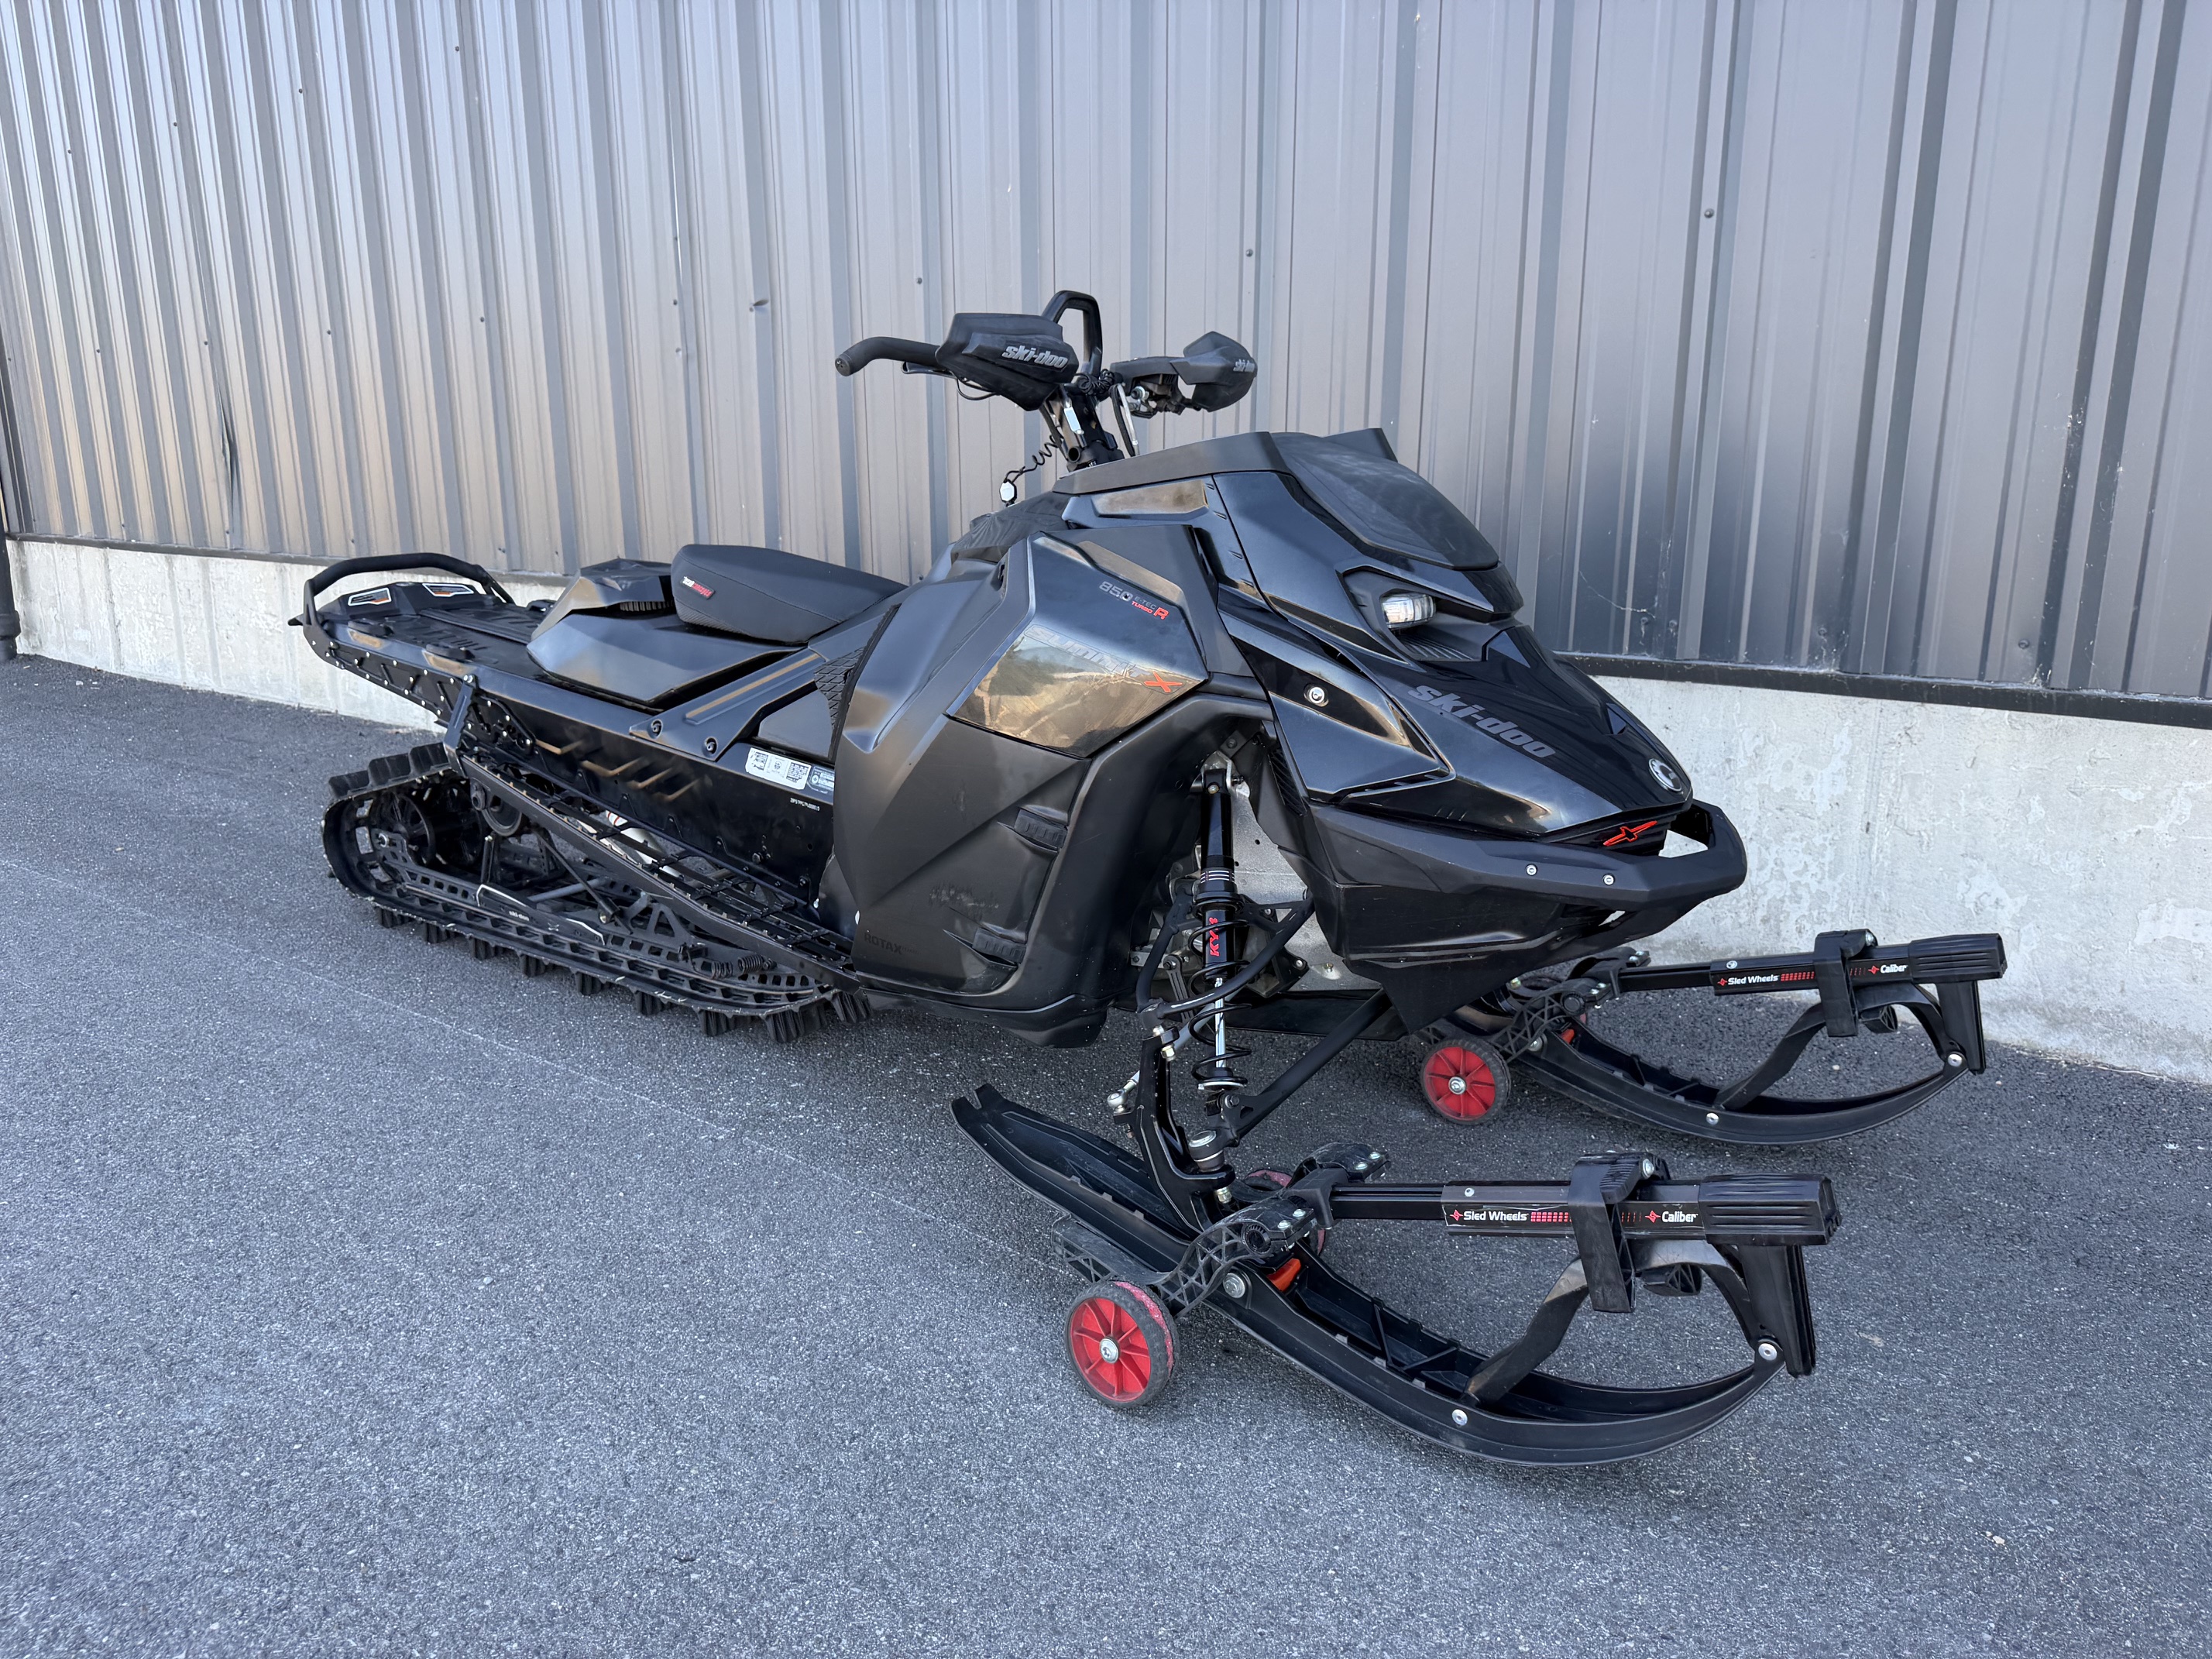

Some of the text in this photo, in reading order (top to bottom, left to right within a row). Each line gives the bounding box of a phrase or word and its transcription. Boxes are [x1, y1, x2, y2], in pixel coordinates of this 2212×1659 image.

[1001, 345, 1068, 369] ski-doo
[1099, 581, 1156, 610] 850 E-TEC
[1132, 600, 1169, 620] TURBO R
[1407, 685, 1556, 758] ski-doo
[864, 932, 902, 955] ROTAX
[1881, 963, 1907, 974] Caliber
[1727, 974, 1779, 985] Sled Wheels
[1463, 1211, 1527, 1221] Sled Wheels
[1662, 1211, 1696, 1223] Caliber
